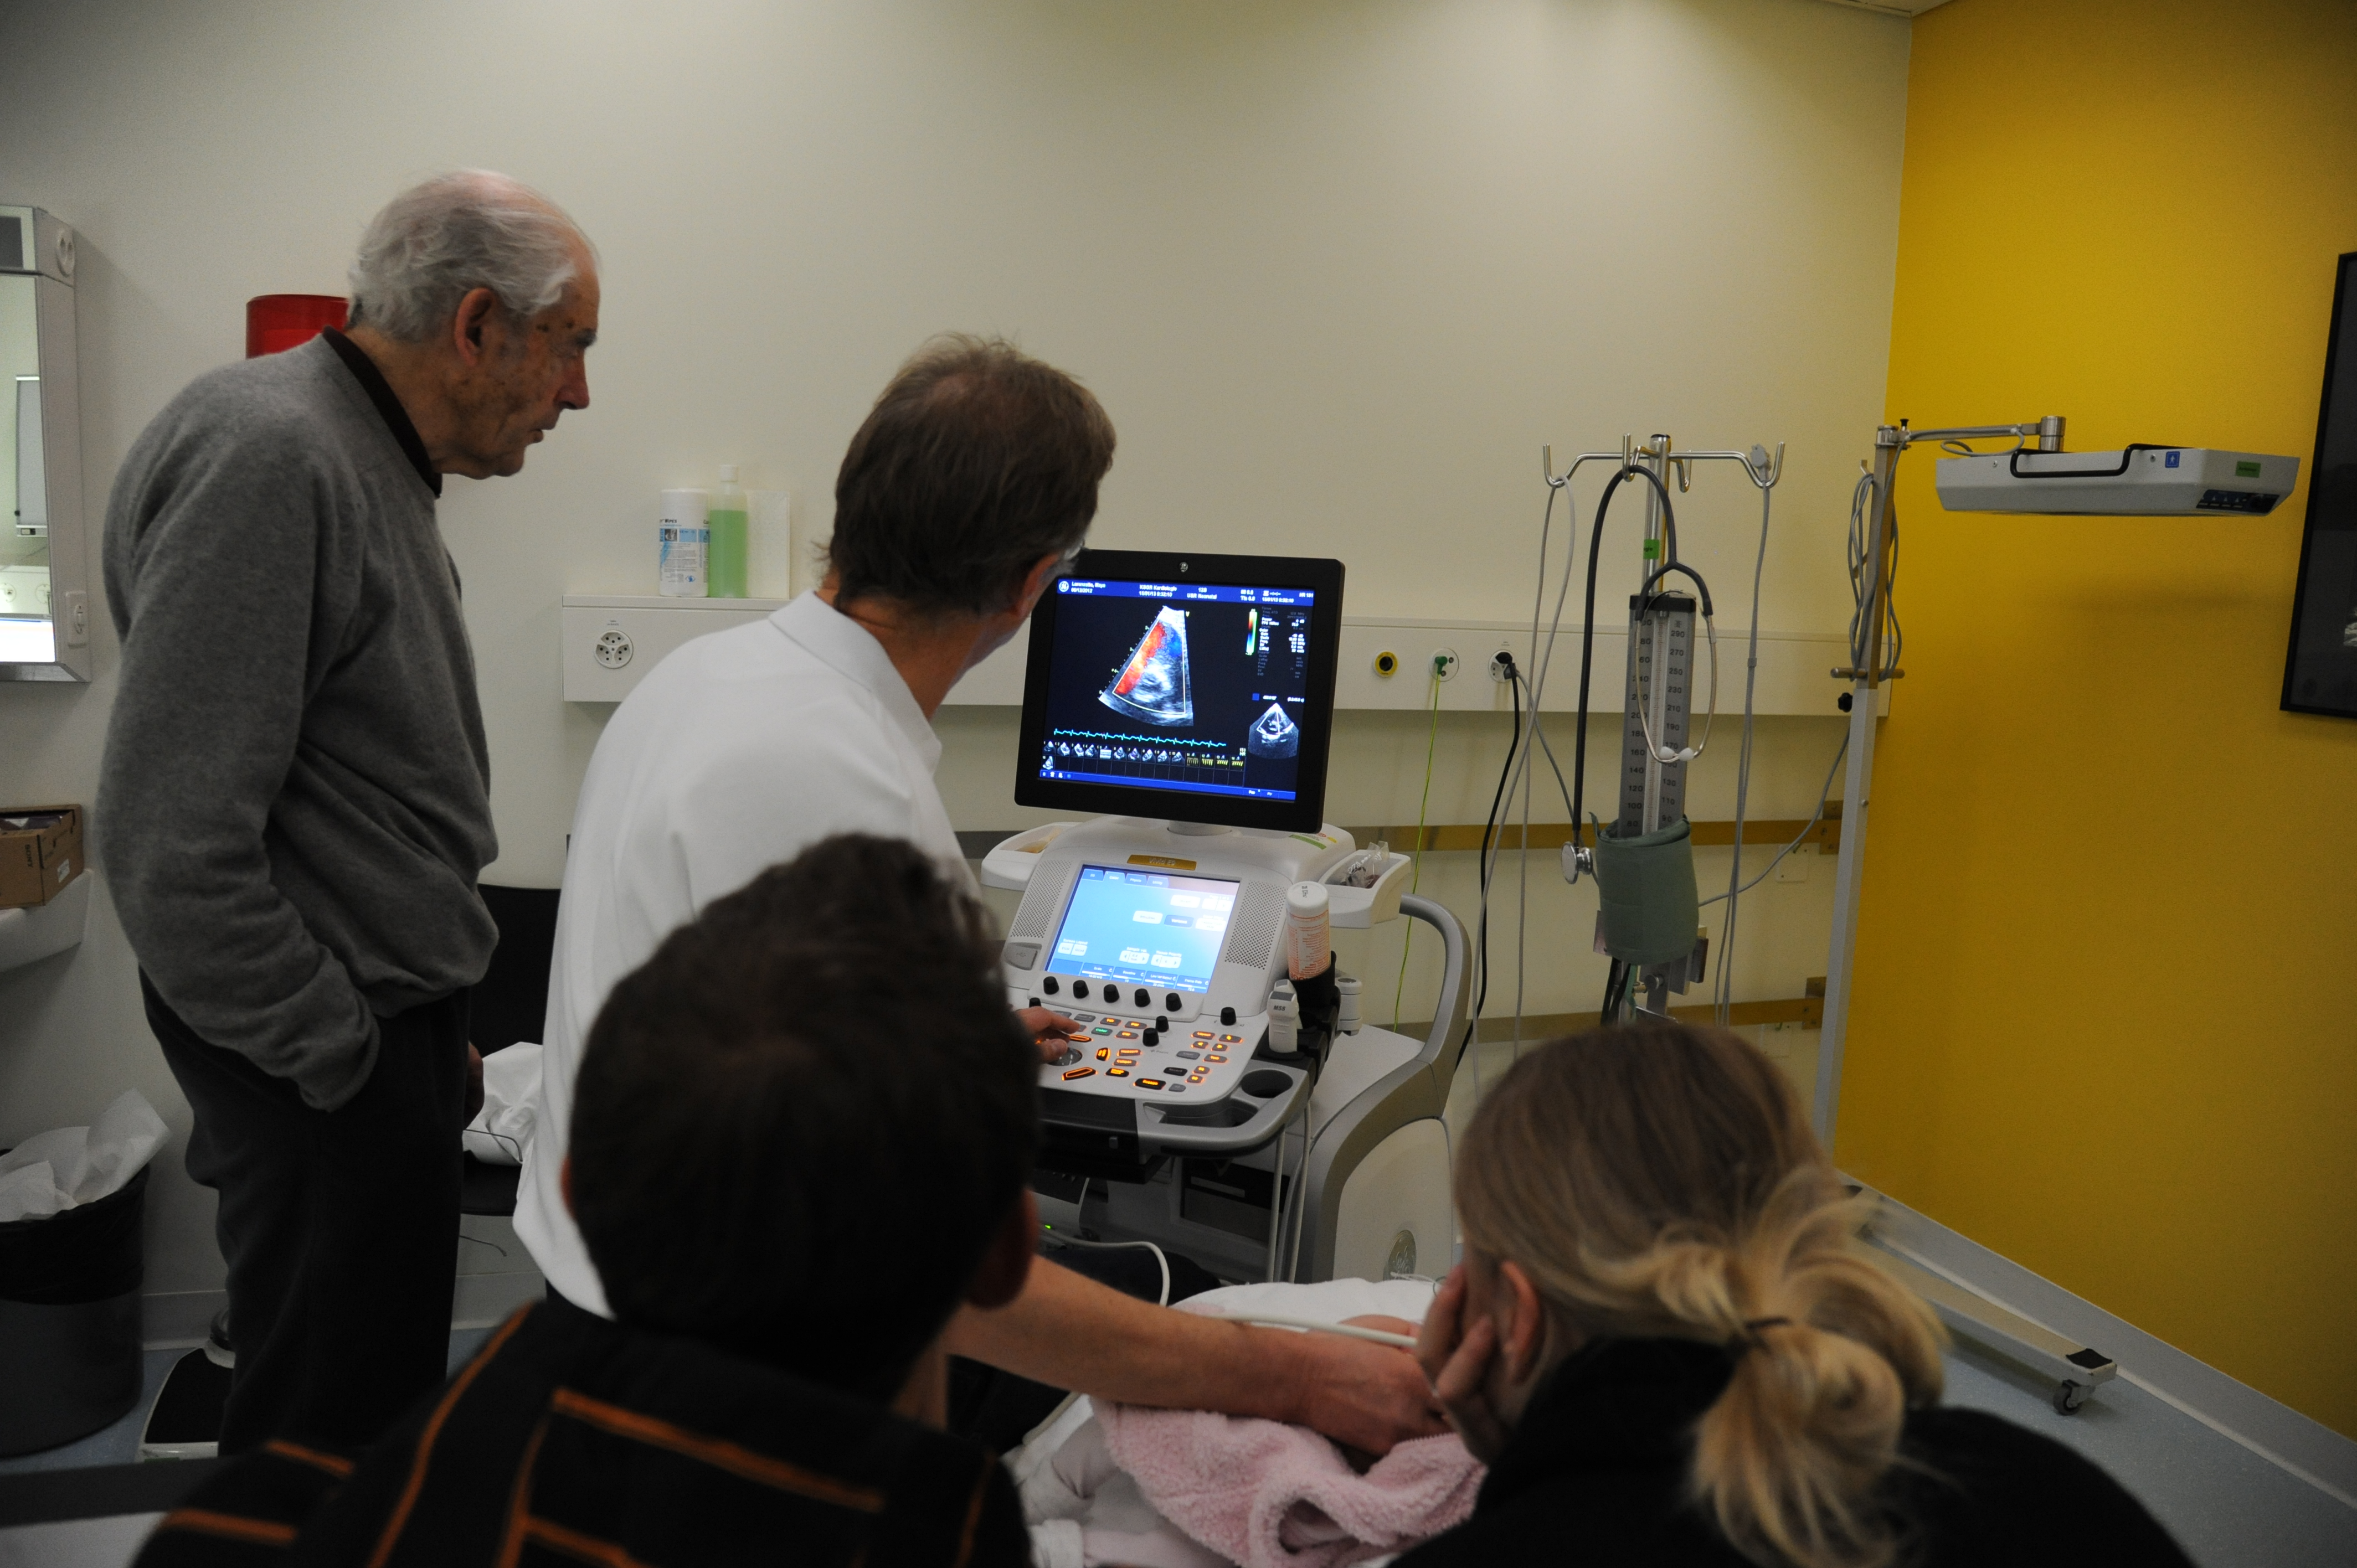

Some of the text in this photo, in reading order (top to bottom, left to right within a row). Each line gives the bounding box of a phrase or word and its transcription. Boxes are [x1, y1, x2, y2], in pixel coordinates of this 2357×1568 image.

[1663, 778, 1676, 787] 130
[1662, 797, 1675, 805] 110
[1661, 814, 1672, 823] 90
